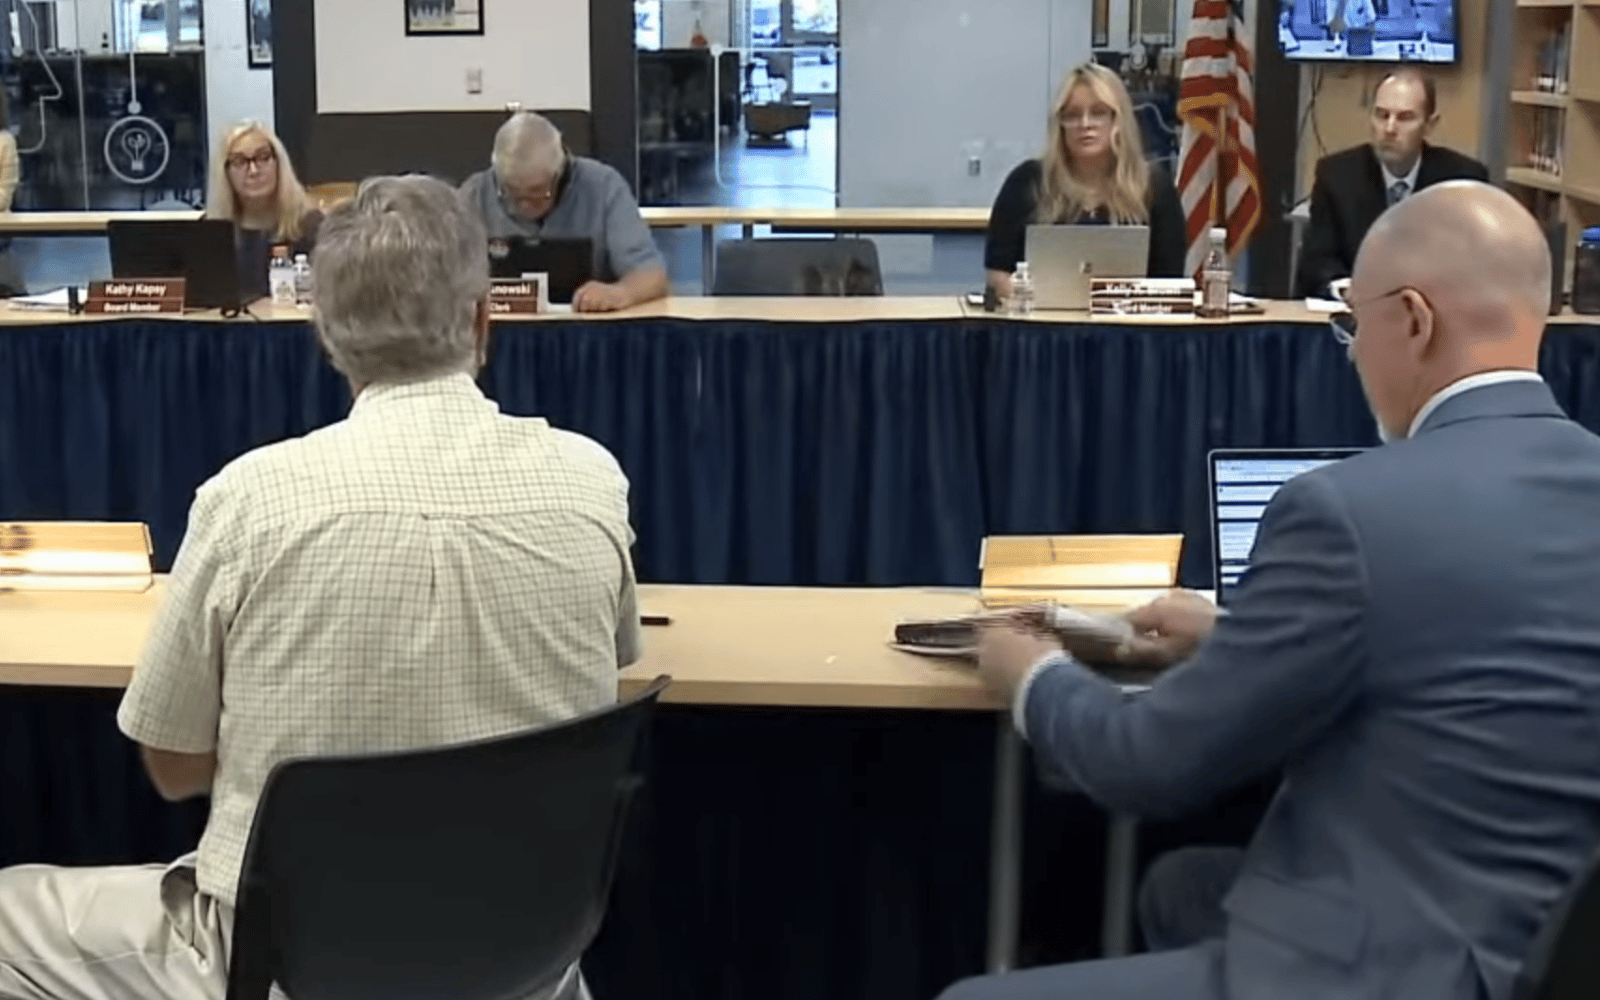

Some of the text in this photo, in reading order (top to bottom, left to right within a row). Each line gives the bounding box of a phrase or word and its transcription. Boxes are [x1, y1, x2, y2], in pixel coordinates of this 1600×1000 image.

[105, 283, 134, 297] Kathy
[103, 302, 161, 312] Board Member
